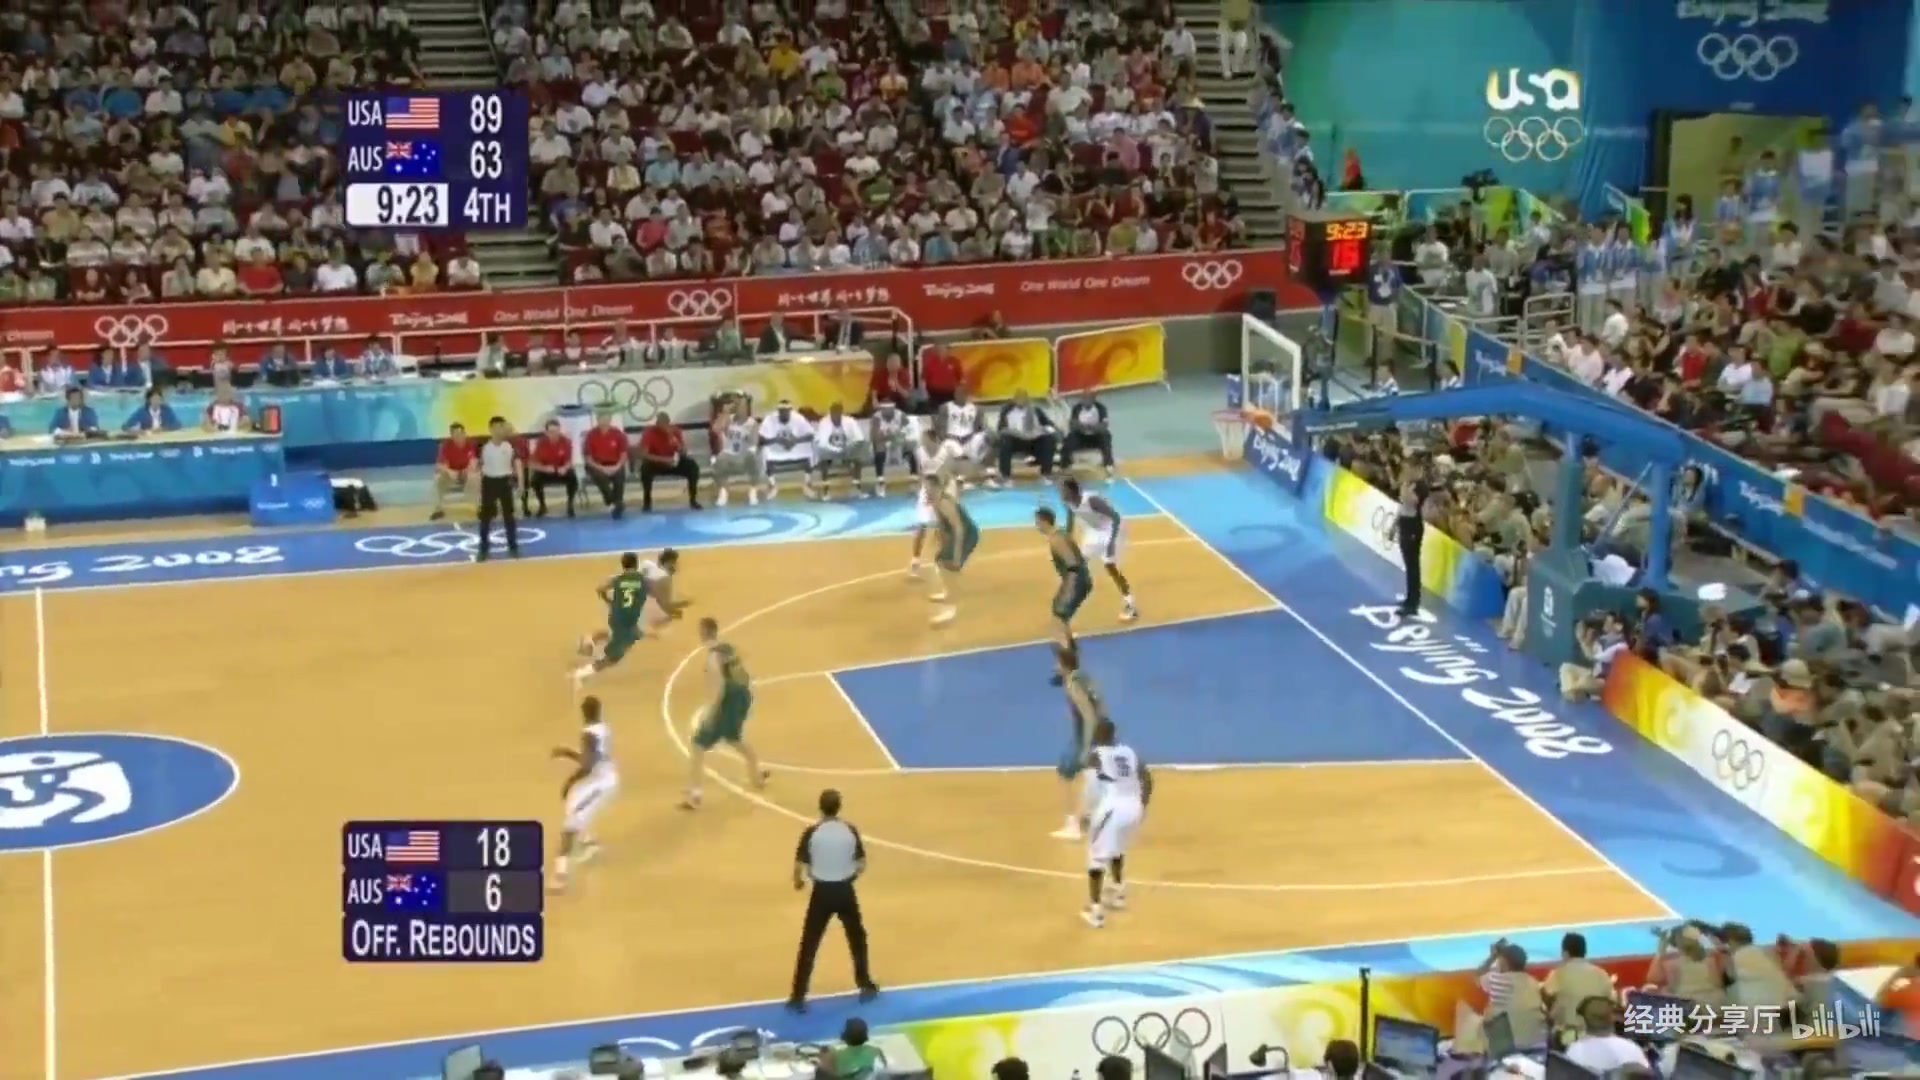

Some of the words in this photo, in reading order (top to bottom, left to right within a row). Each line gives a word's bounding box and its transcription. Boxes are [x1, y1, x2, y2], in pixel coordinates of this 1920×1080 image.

[1325, 221, 1368, 241] 9:23
[90, 545, 285, 573] 2008
[1349, 593, 1499, 685] Beijing
[1461, 686, 1614, 759] 2008
